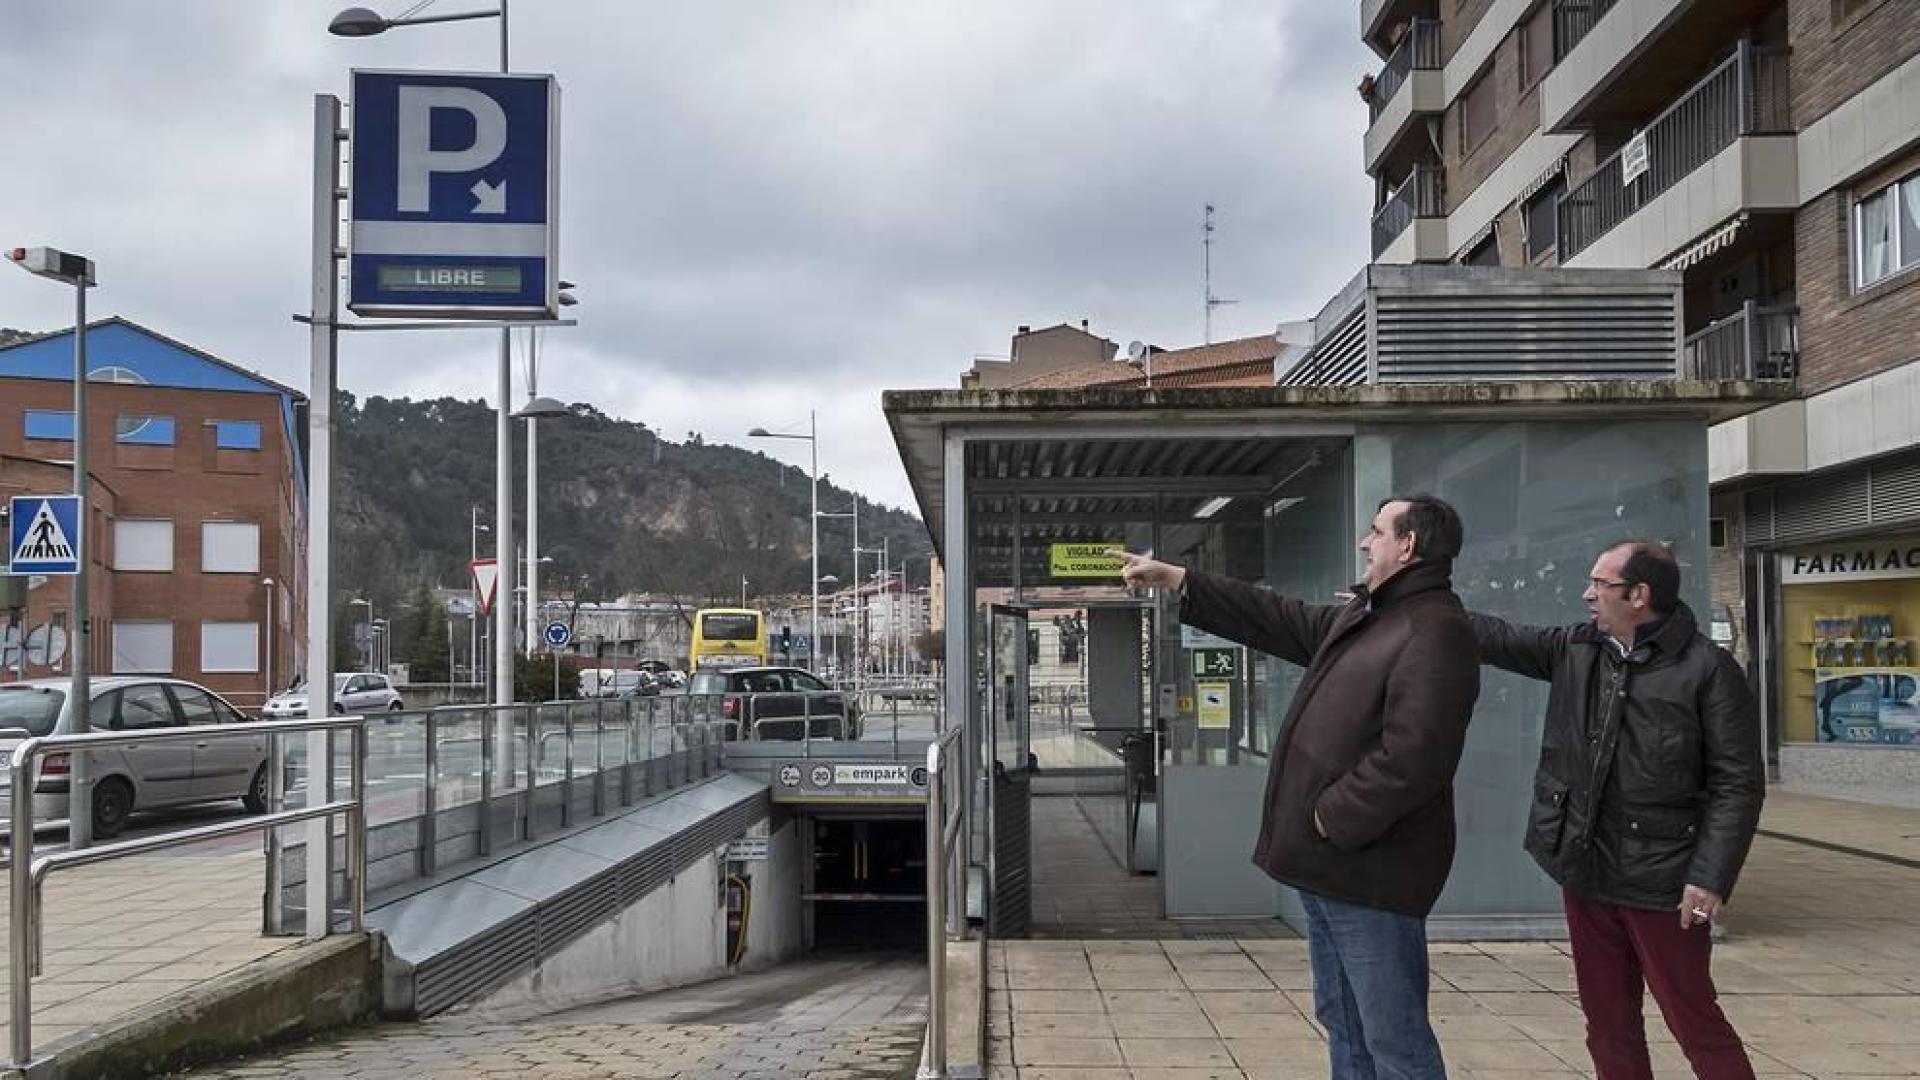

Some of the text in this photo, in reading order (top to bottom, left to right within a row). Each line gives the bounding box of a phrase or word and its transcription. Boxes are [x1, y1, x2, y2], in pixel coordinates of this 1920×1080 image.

[397, 85, 507, 212] P
[415, 269, 485, 285] LIBRE
[1066, 546, 1110, 556] VIGILAD
[852, 767, 906, 782] empark
